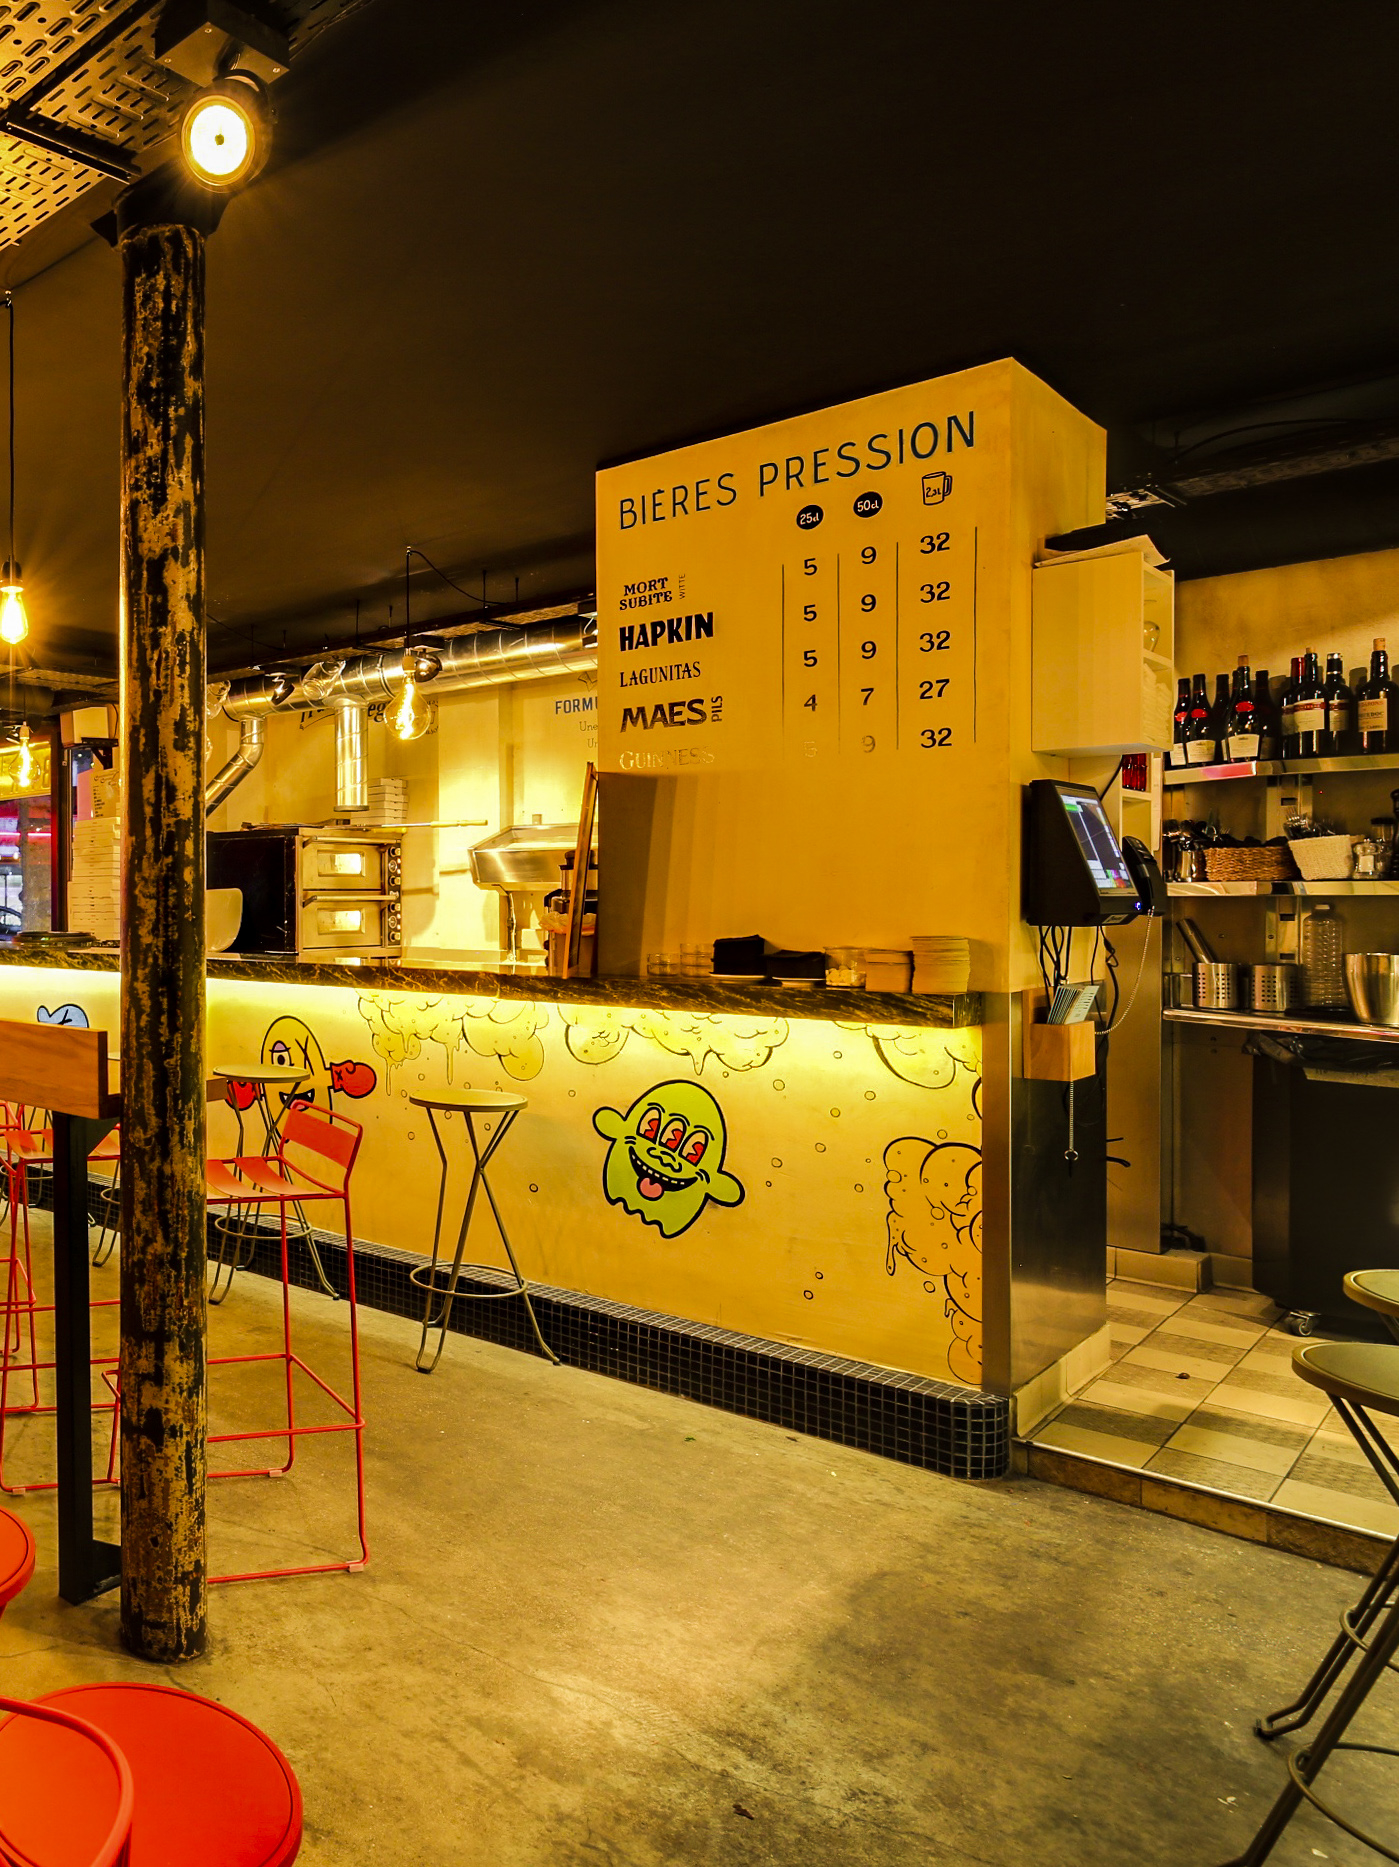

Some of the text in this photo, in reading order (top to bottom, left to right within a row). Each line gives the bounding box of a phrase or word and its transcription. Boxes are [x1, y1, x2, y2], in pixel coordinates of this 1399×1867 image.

[758, 411, 975, 498] PRESSION
[803, 531, 951, 576] 5 9 32
[619, 590, 673, 611] SUBITE
[623, 576, 669, 597] MORT
[678, 573, 686, 600] WITTE
[803, 581, 951, 622] 5 9 32
[618, 611, 714, 652] HAPKIN
[803, 630, 951, 668] 5 9 32
[619, 660, 701, 688] LAGUNITAS
[555, 696, 599, 715] FORM
[803, 678, 950, 712] 4 7 27
[619, 695, 724, 734] MAES PILS
[803, 727, 953, 758] 5 9 32
